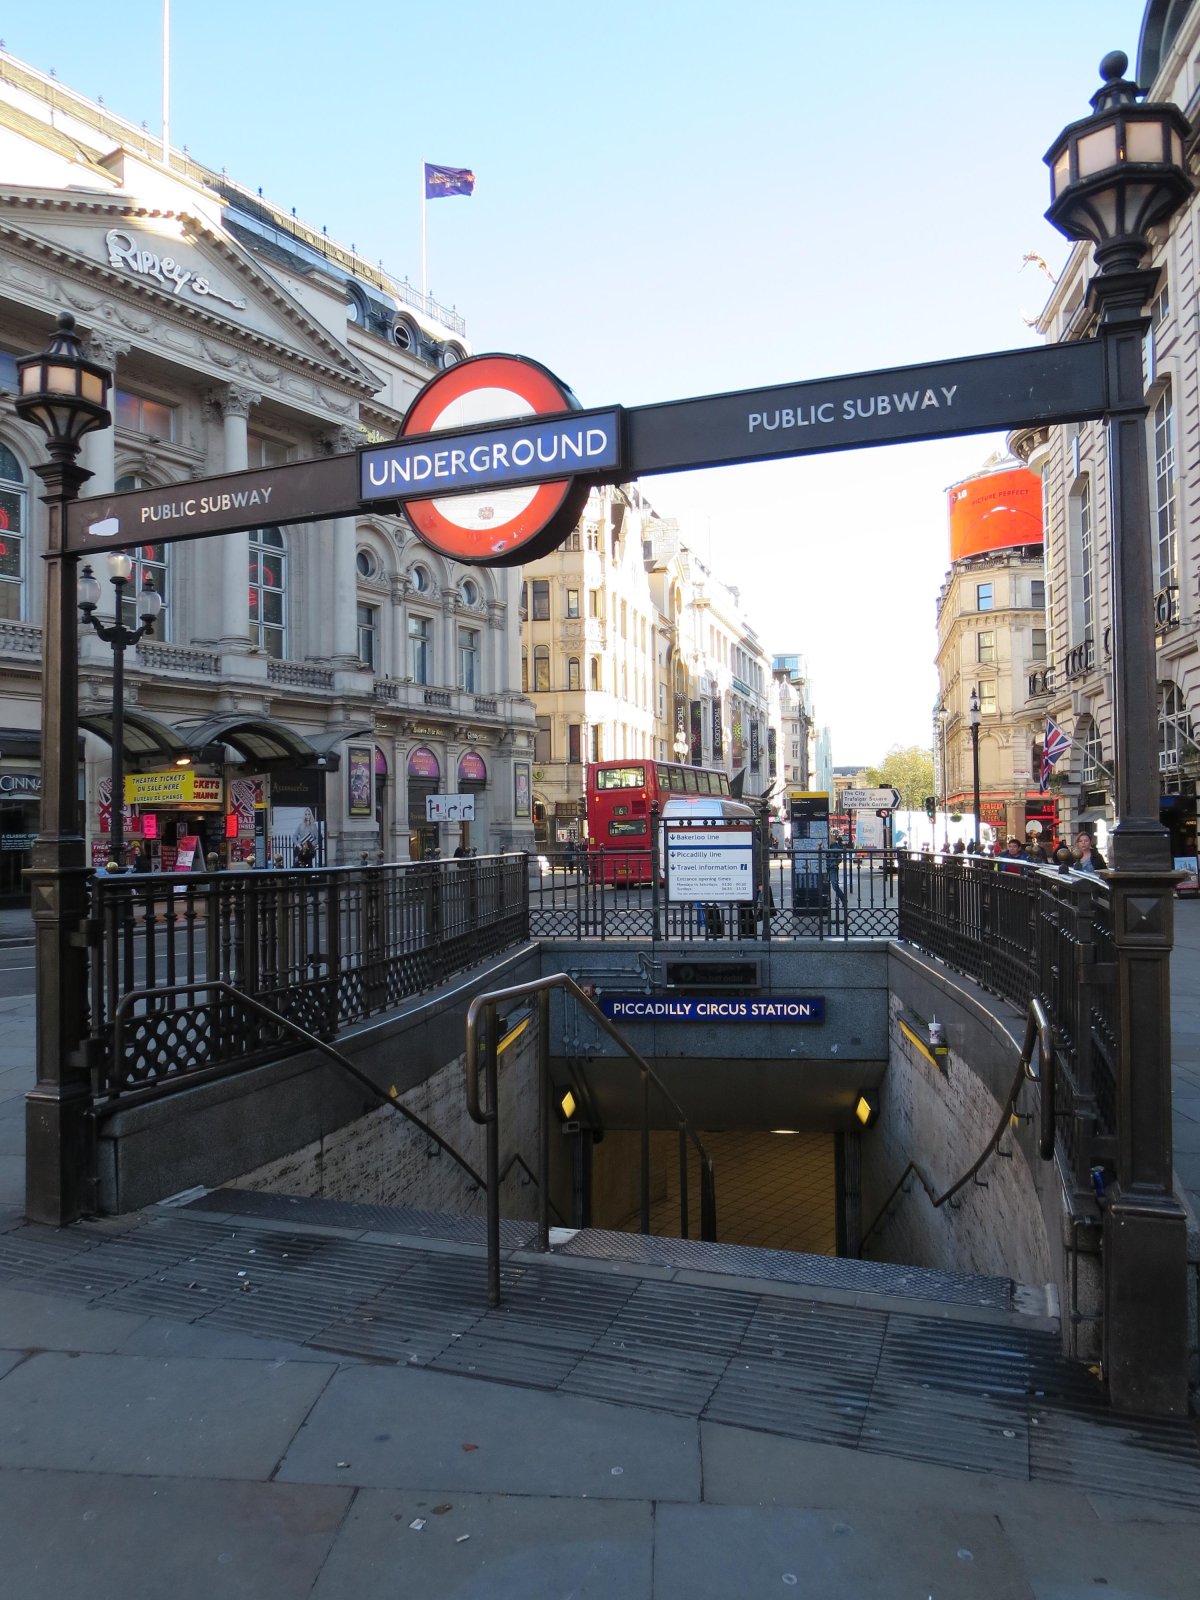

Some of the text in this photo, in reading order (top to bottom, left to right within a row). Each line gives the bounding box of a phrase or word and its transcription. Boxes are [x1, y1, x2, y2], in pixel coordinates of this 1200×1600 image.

[748, 385, 958, 432] PUBLIC SUBWAY
[369, 430, 608, 486] UNDERGROUND
[141, 487, 272, 523] PUBLIC SUBWAY
[998, 489, 1029, 498] PERFECT
[132, 774, 186, 784] THEATRE TICKETS
[613, 1003, 810, 1016] PICCADILLY CIRCUS STATION
